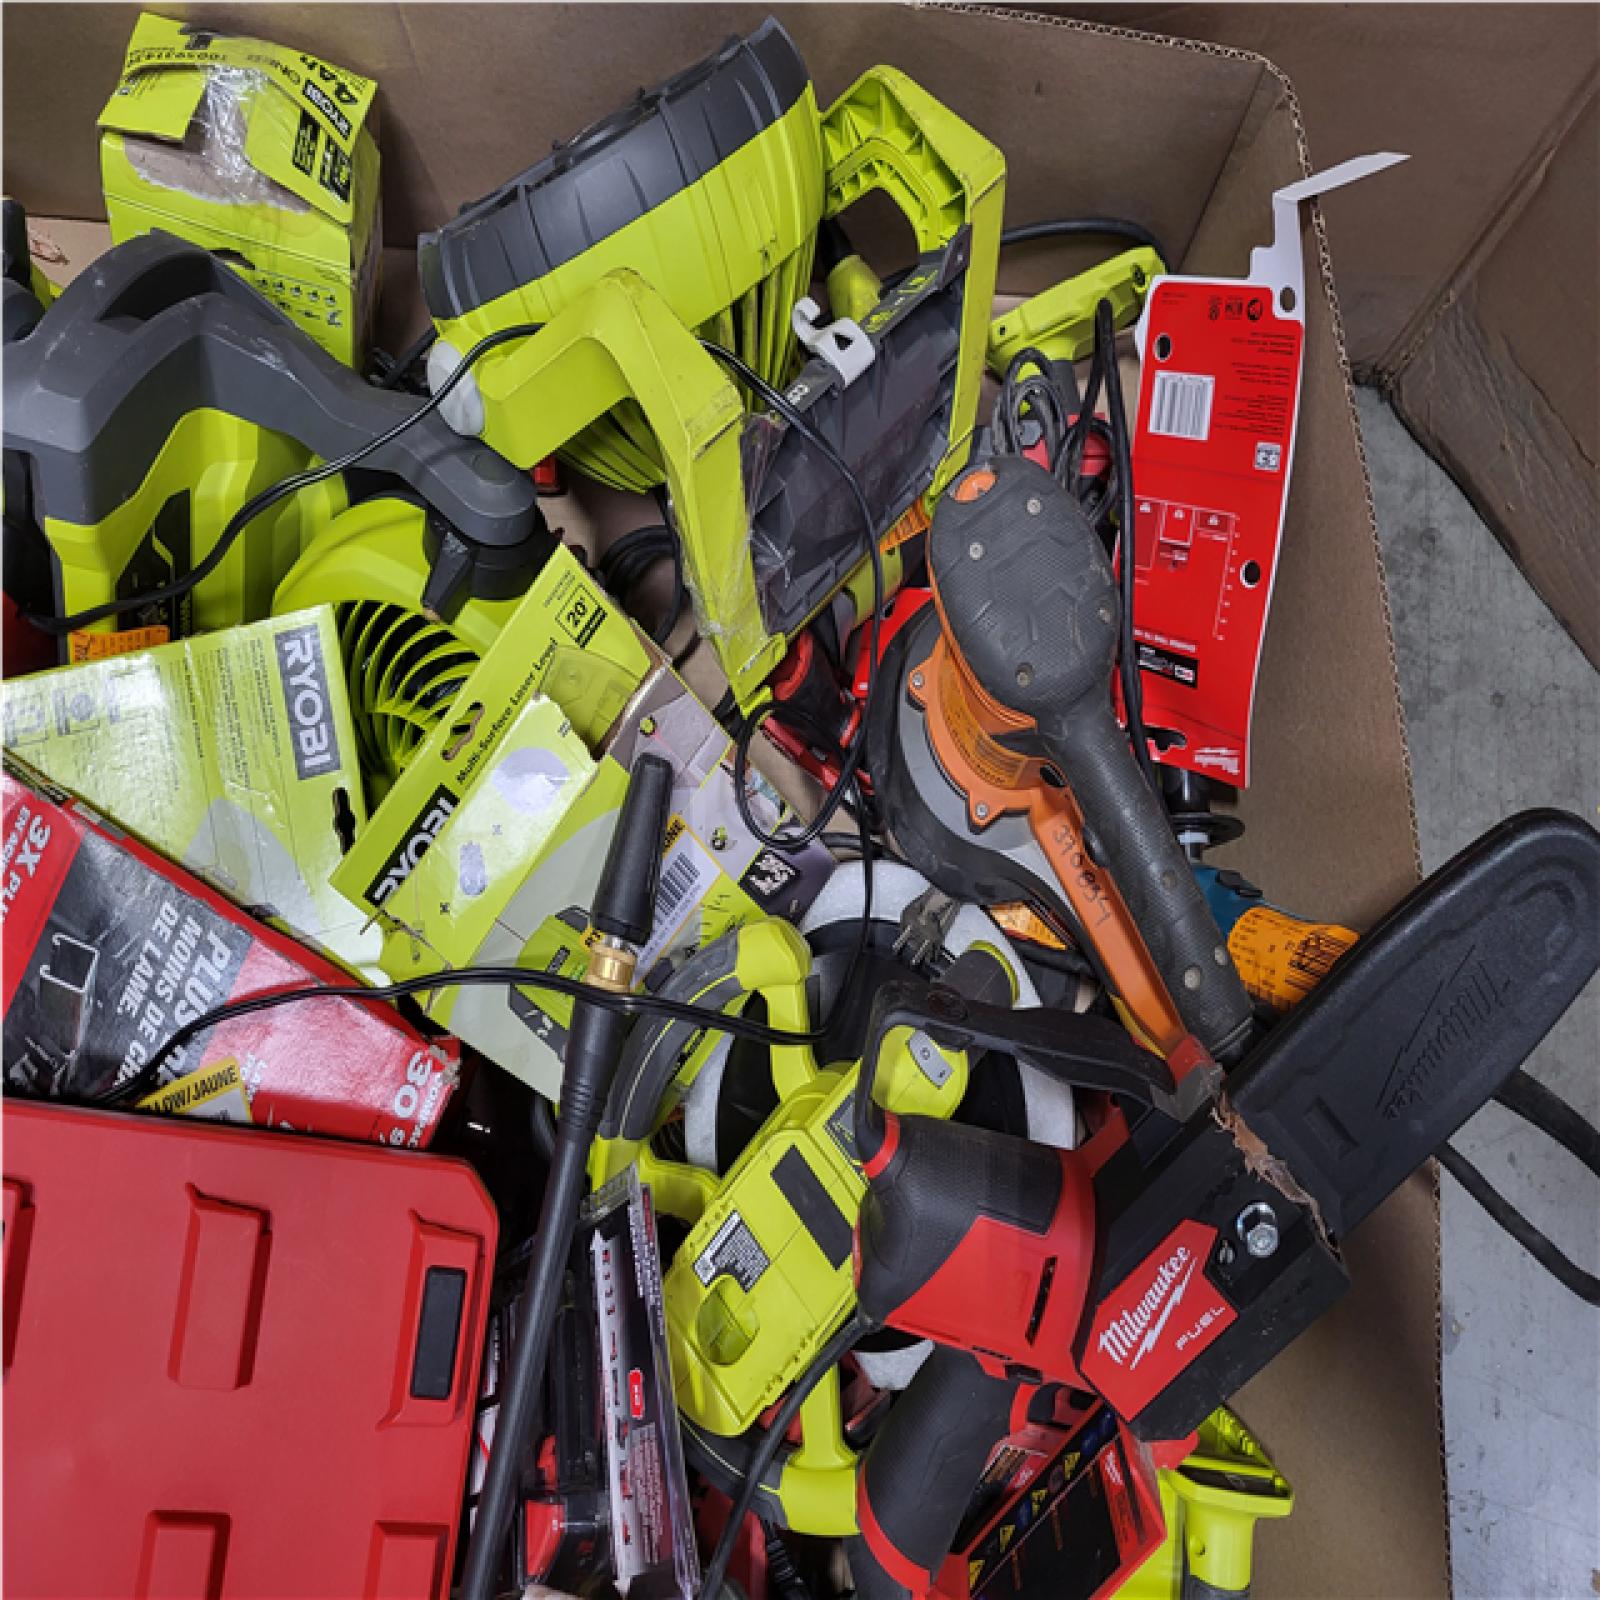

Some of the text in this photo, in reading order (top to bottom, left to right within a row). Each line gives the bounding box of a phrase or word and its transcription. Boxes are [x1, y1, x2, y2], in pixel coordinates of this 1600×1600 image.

[300, 52, 358, 105] 4Ah
[306, 83, 352, 136] RYOBI
[284, 632, 333, 769] RYOBI
[455, 638, 559, 786] Multi-Surface Laser Level
[15, 814, 51, 878] 3X
[116, 901, 180, 1017] DE LAME.
[154, 916, 203, 1008] MOINS
[173, 930, 232, 1033] PLUS
[137, 1003, 166, 1045] DE
[393, 1051, 432, 1118] 30
[1098, 1246, 1192, 1366] Milwaukee
[1176, 1306, 1226, 1351] FUEL
